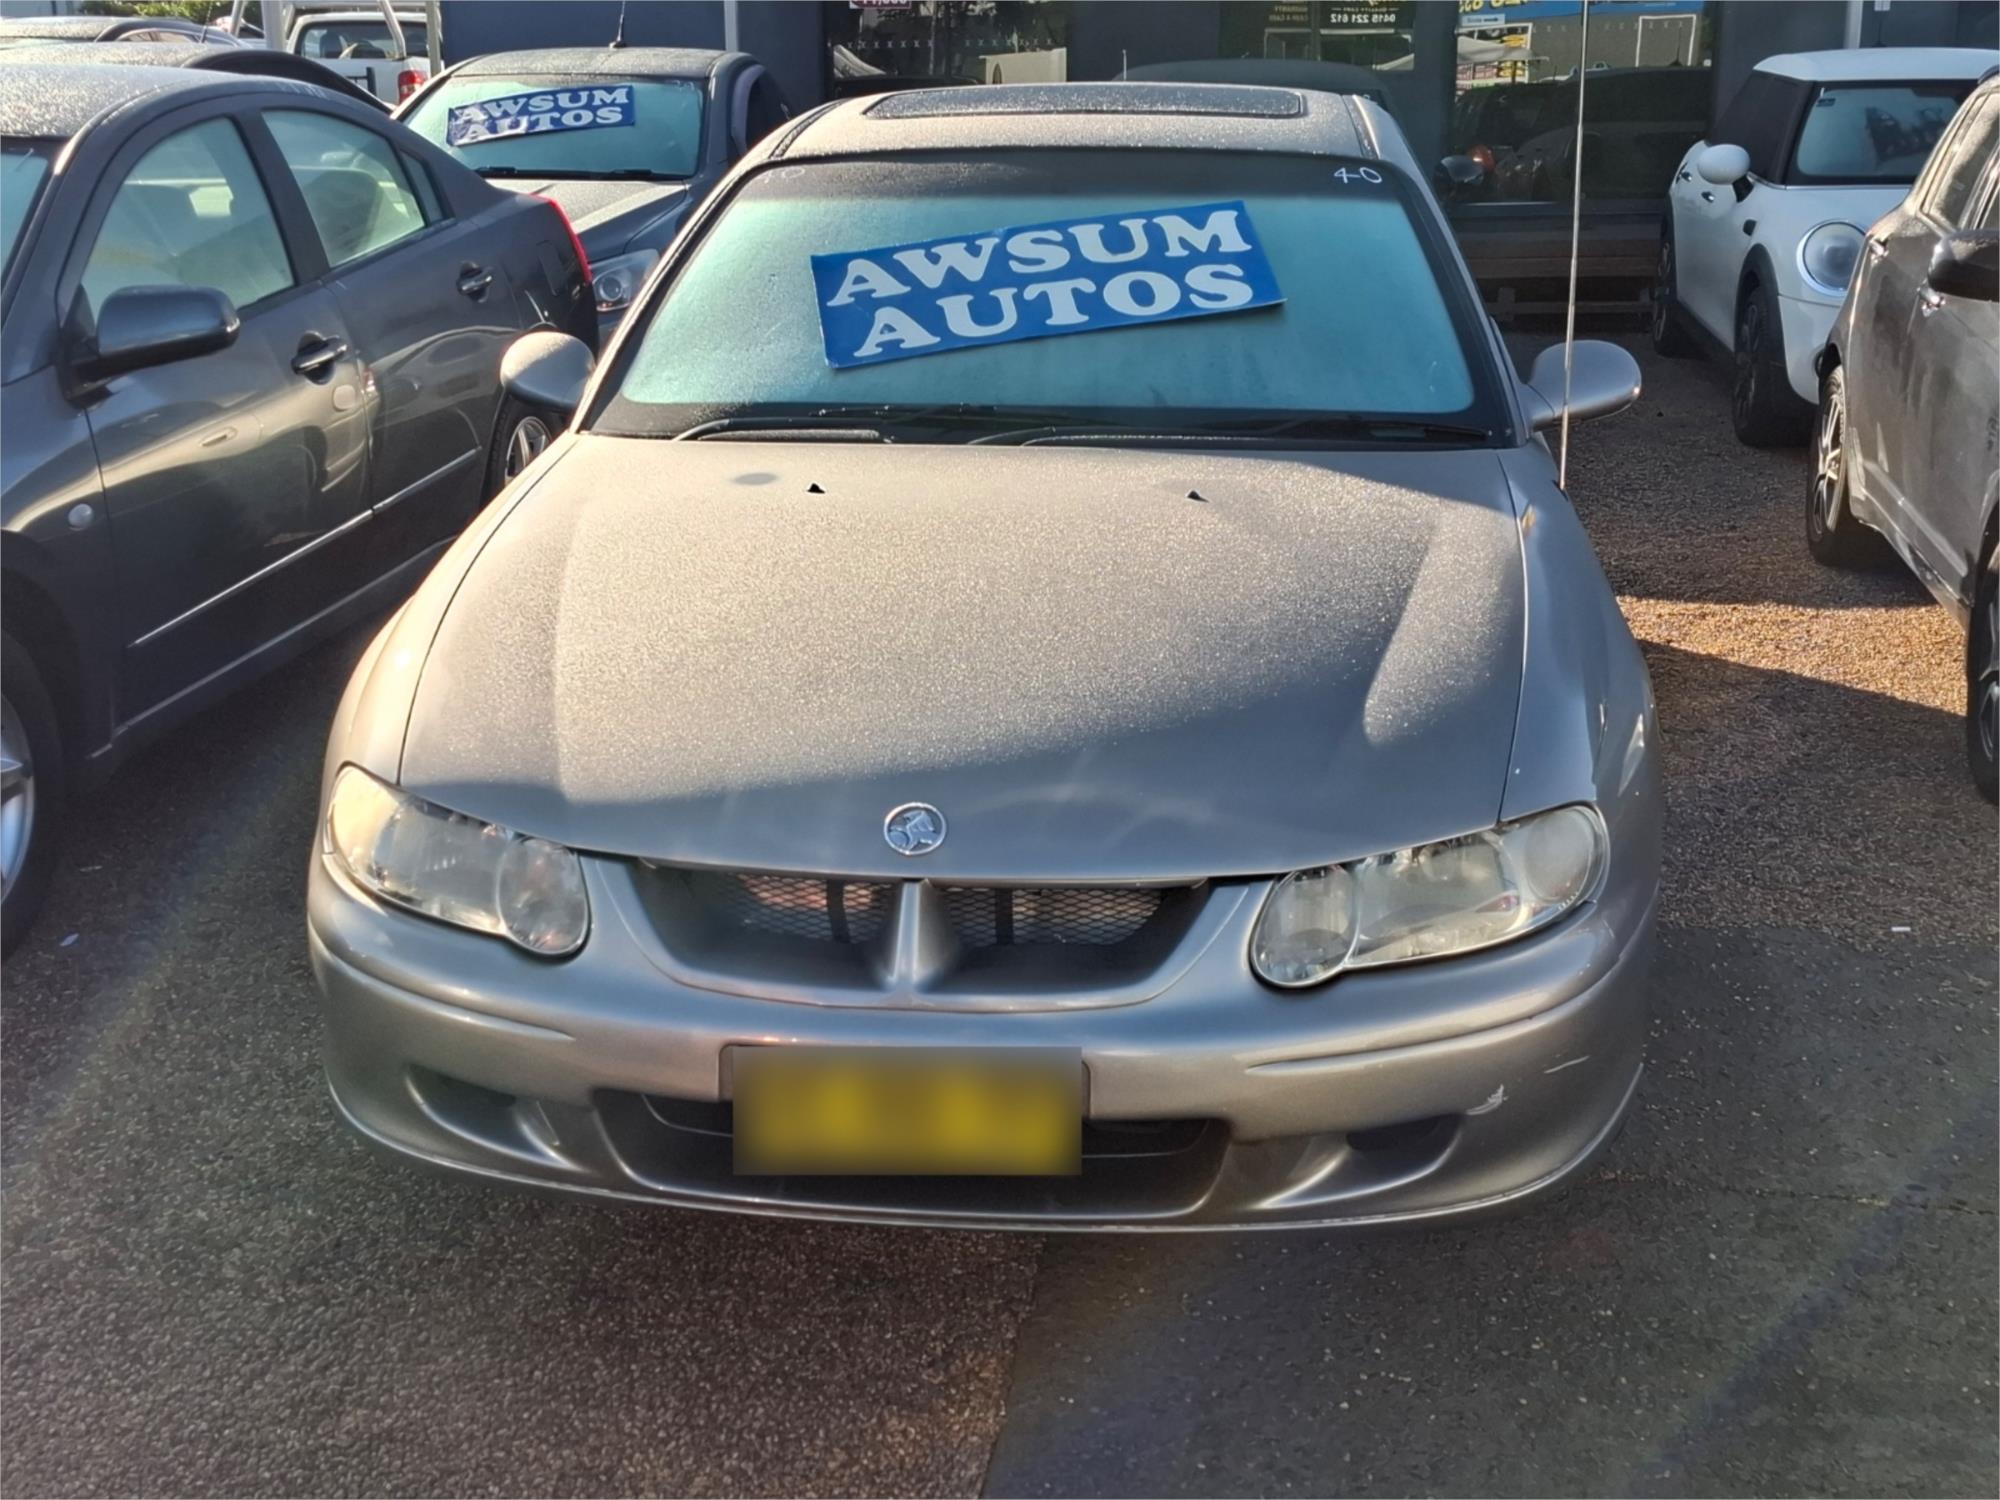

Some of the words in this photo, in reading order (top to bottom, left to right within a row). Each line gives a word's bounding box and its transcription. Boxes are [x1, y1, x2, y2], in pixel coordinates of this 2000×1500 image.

[453, 87, 629, 124] AWSUM
[454, 106, 623, 145] AUTOS
[826, 209, 1252, 307] AWSUM
[853, 263, 1254, 357] AUTOS
